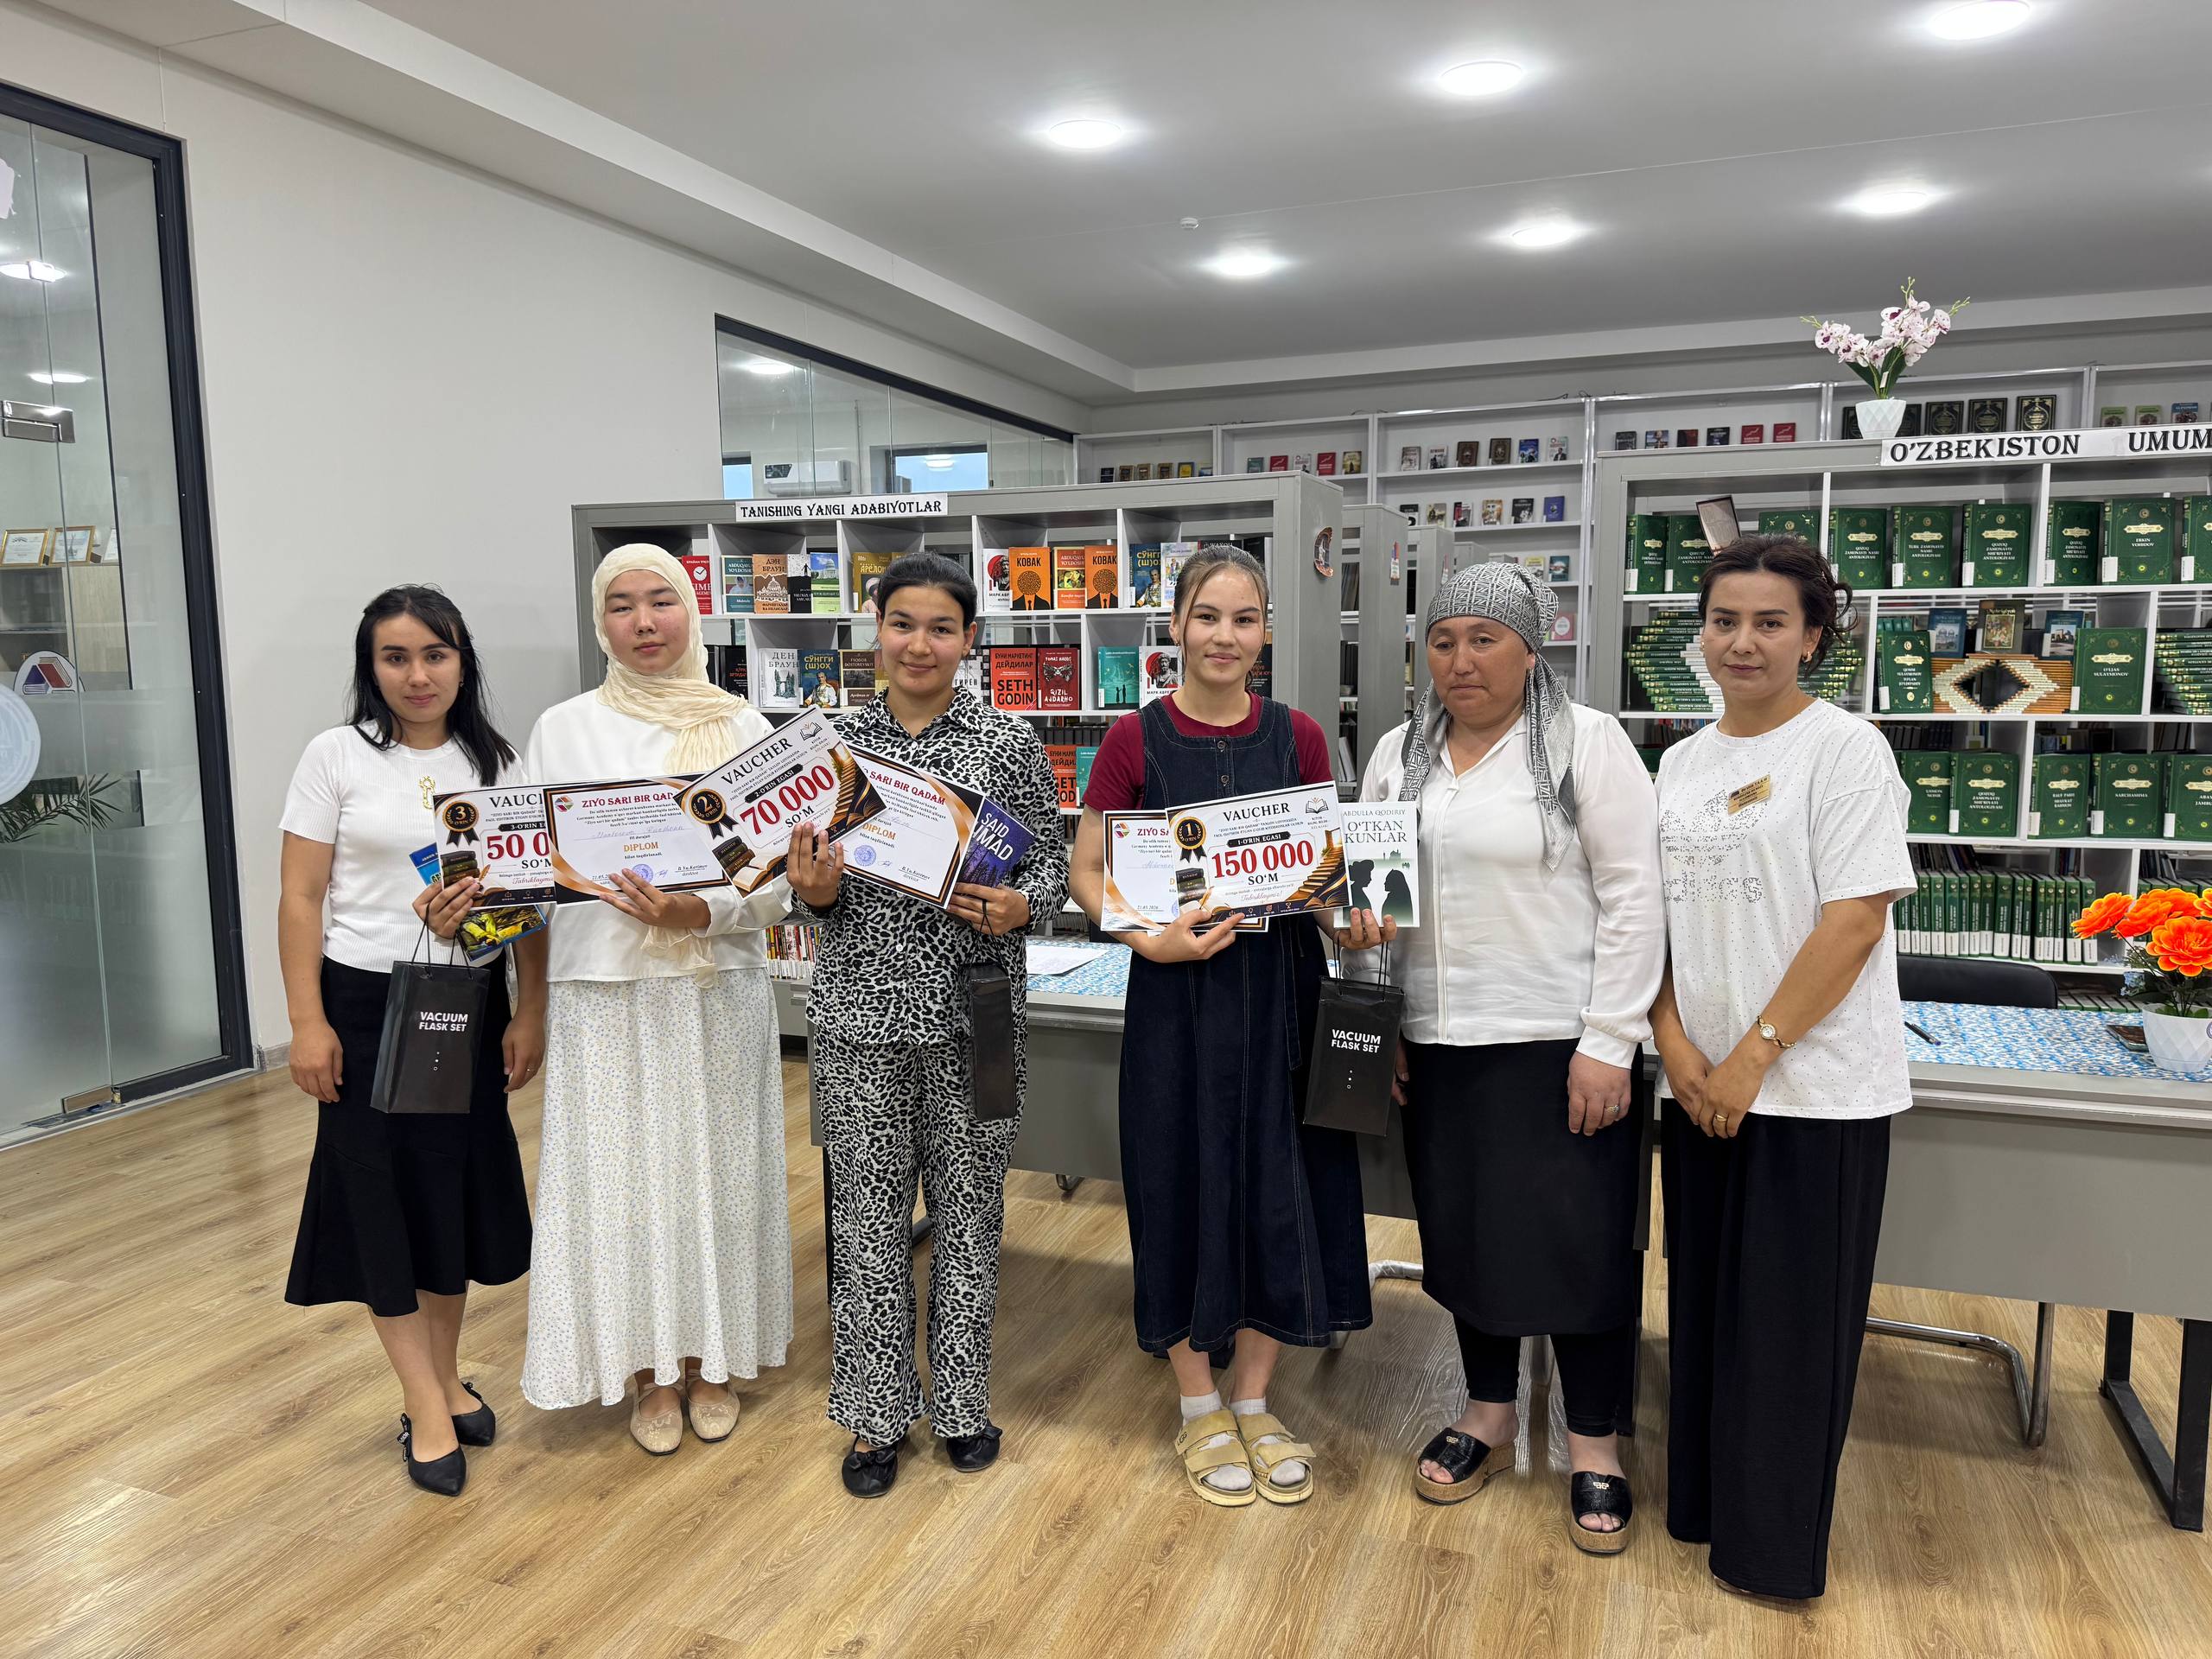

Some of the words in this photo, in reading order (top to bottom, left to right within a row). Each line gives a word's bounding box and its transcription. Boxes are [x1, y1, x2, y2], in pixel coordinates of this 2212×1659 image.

[1891, 435, 2081, 462] O'ZBEKISTON
[2128, 429, 2212, 452] UMUM
[741, 505, 802, 517] TANISHING
[807, 503, 845, 516] YANGI
[851, 500, 941, 514] ADABIYOTLAR
[995, 660, 1033, 669] ДЕЙДИЛАР
[997, 679, 1033, 691] SETH
[997, 693, 1033, 705] GODIN
[721, 737, 793, 785] VAUCHER
[777, 770, 795, 785] EGASI
[869, 771, 893, 785] SARI
[894, 780, 910, 791] BIR
[912, 787, 946, 805] QADAM
[582, 798, 605, 808] ZIYO
[607, 796, 632, 805] SARI
[633, 793, 651, 803] BIR
[697, 797, 712, 812] 2
[740, 799, 780, 836] 70
[779, 765, 835, 811] 000
[455, 806, 466, 821] 3
[785, 805, 815, 828] SO'M
[1224, 803, 1291, 822] VAUCHER
[862, 822, 896, 840] DIPLOM
[981, 812, 1010, 838] SAID
[1137, 827, 1157, 836] ZIYO
[1185, 823, 1193, 836] 1
[1348, 821, 1403, 831] O'TKAN
[1345, 832, 1407, 843] KUNLAR
[486, 834, 524, 860] 50
[623, 842, 658, 852] DIPLOM
[1211, 848, 1257, 878] 150
[1262, 840, 1313, 871] 000
[1248, 873, 1279, 885] SO'M
[420, 1011, 468, 1023] VACUUM
[419, 1021, 448, 1032] FLASK
[450, 1022, 467, 1032] SET
[1332, 1029, 1381, 1045] VACUUM
[1331, 1039, 1360, 1051] FLASK
[1362, 1044, 1380, 1053] SET
